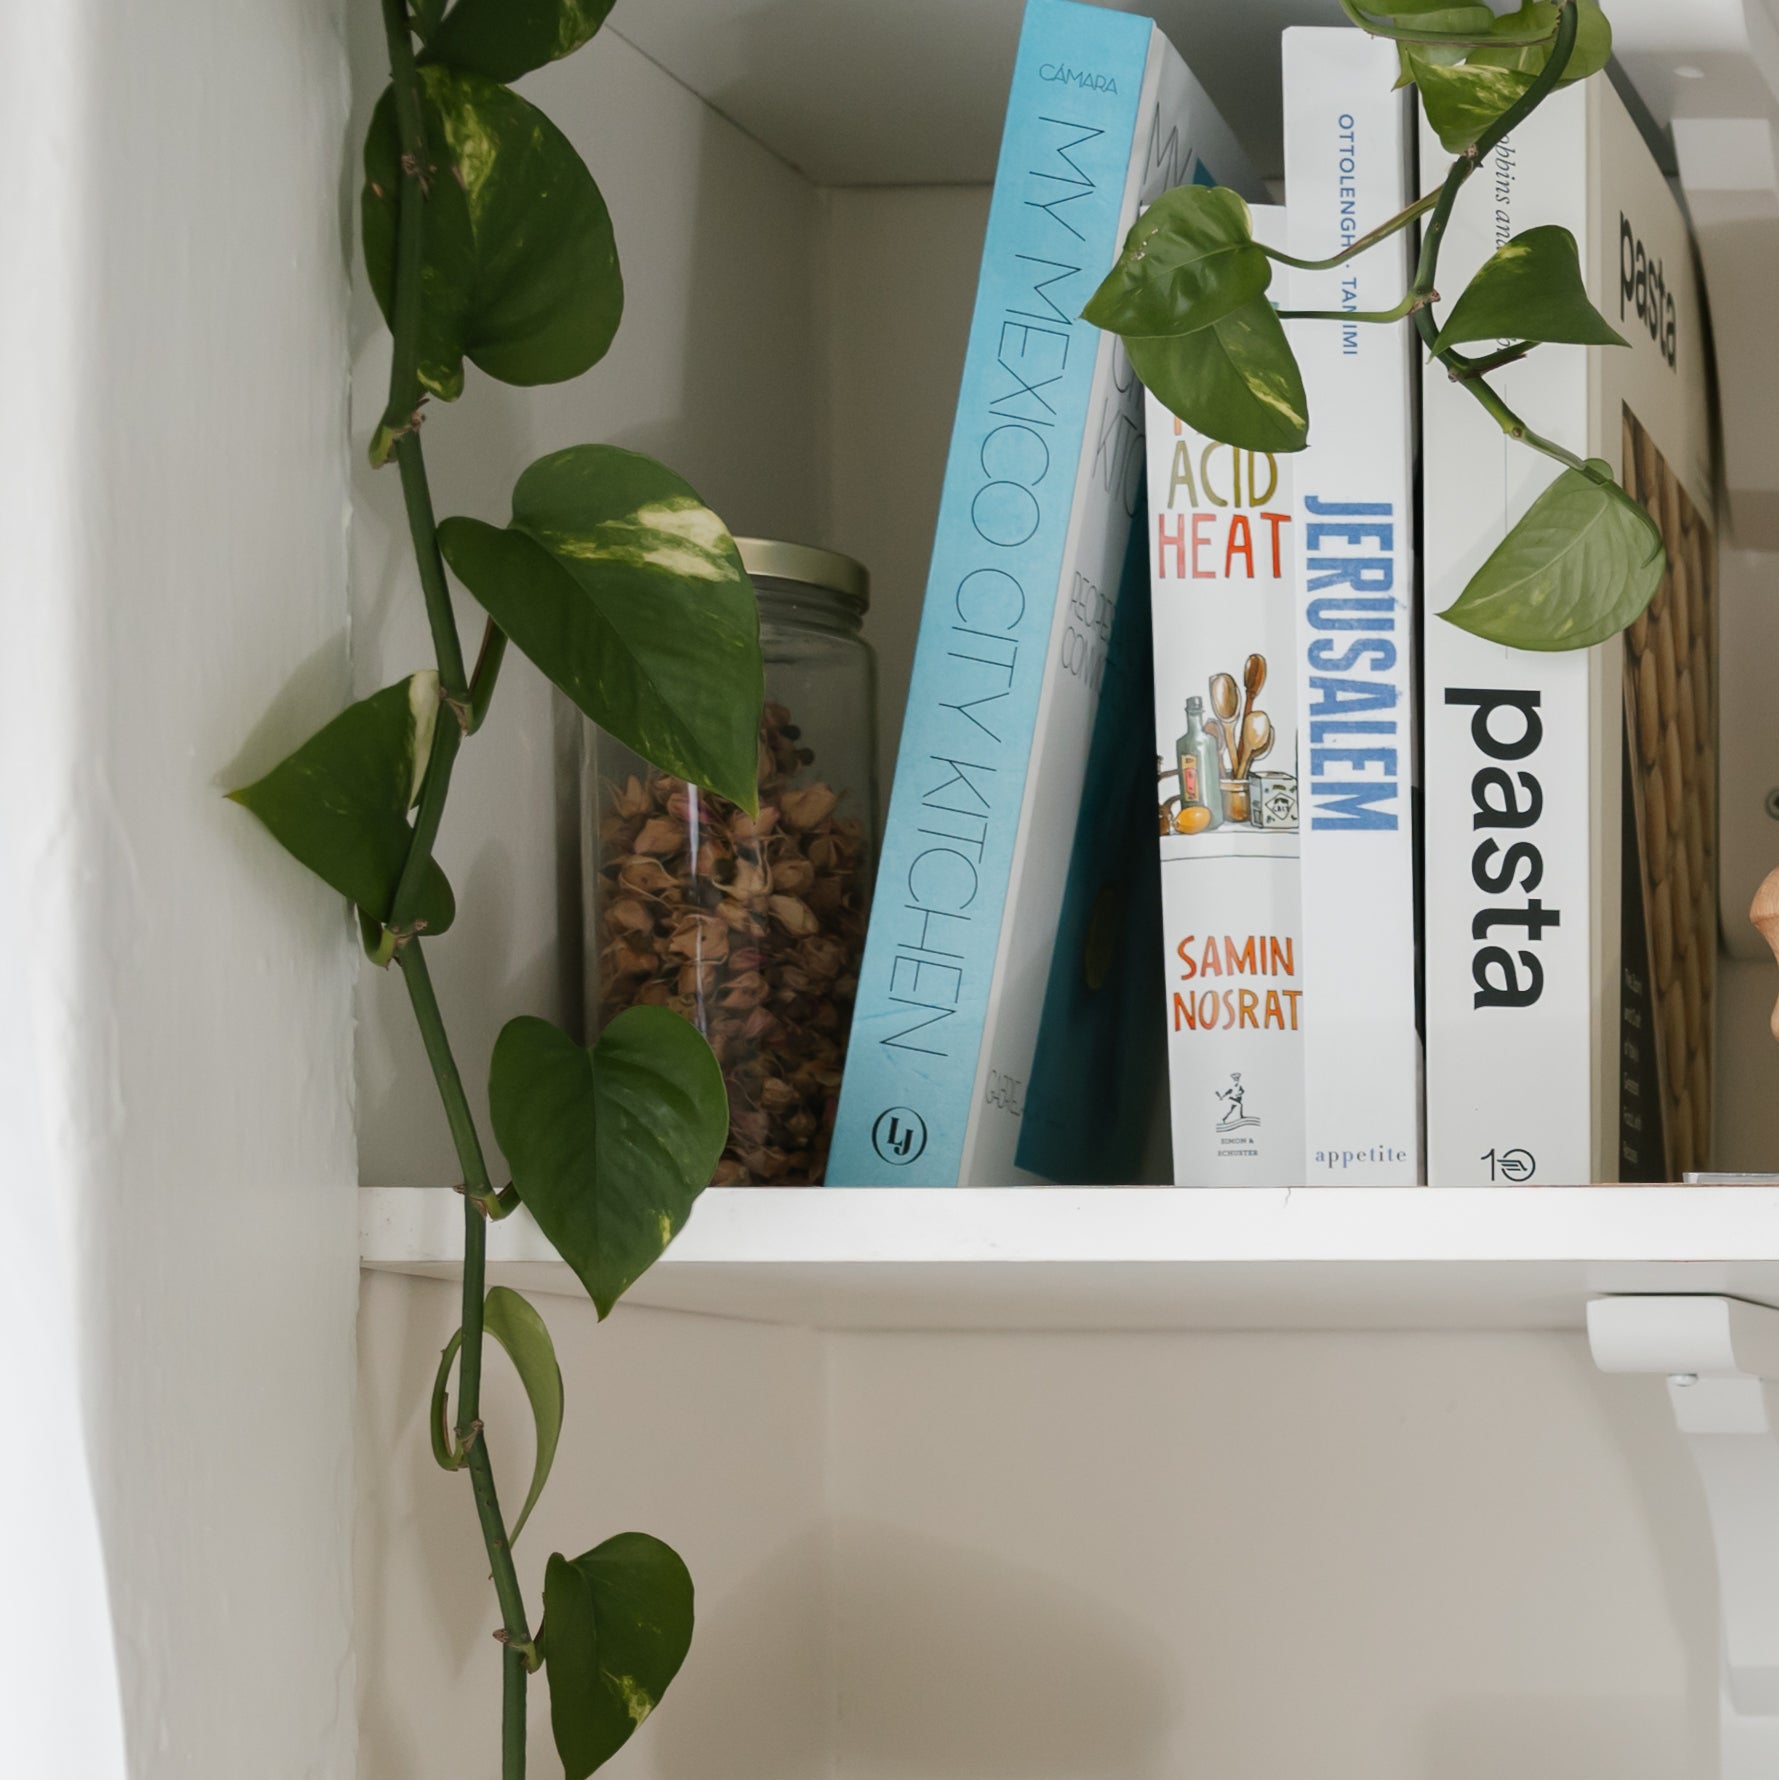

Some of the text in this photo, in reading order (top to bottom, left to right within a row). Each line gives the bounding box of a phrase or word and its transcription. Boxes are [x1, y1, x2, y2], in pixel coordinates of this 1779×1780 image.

[1038, 63, 1118, 95] CÁMARA
[1338, 113, 1356, 249] OTTOLENGH
[1496, 134, 1516, 204] obbins
[1619, 209, 1677, 375] pasta
[1166, 438, 1278, 509] ACID
[1158, 511, 1292, 579] HEAT
[879, 116, 1105, 1057] MY MEXICO CITY KITCHEN
[1304, 495, 1399, 831] JERUSALEM
[1444, 687, 1561, 1011] pasta
[1177, 934, 1295, 981] SAMIN
[1172, 988, 1303, 1032] NOSRAT
[1314, 1145, 1408, 1168] appetite
